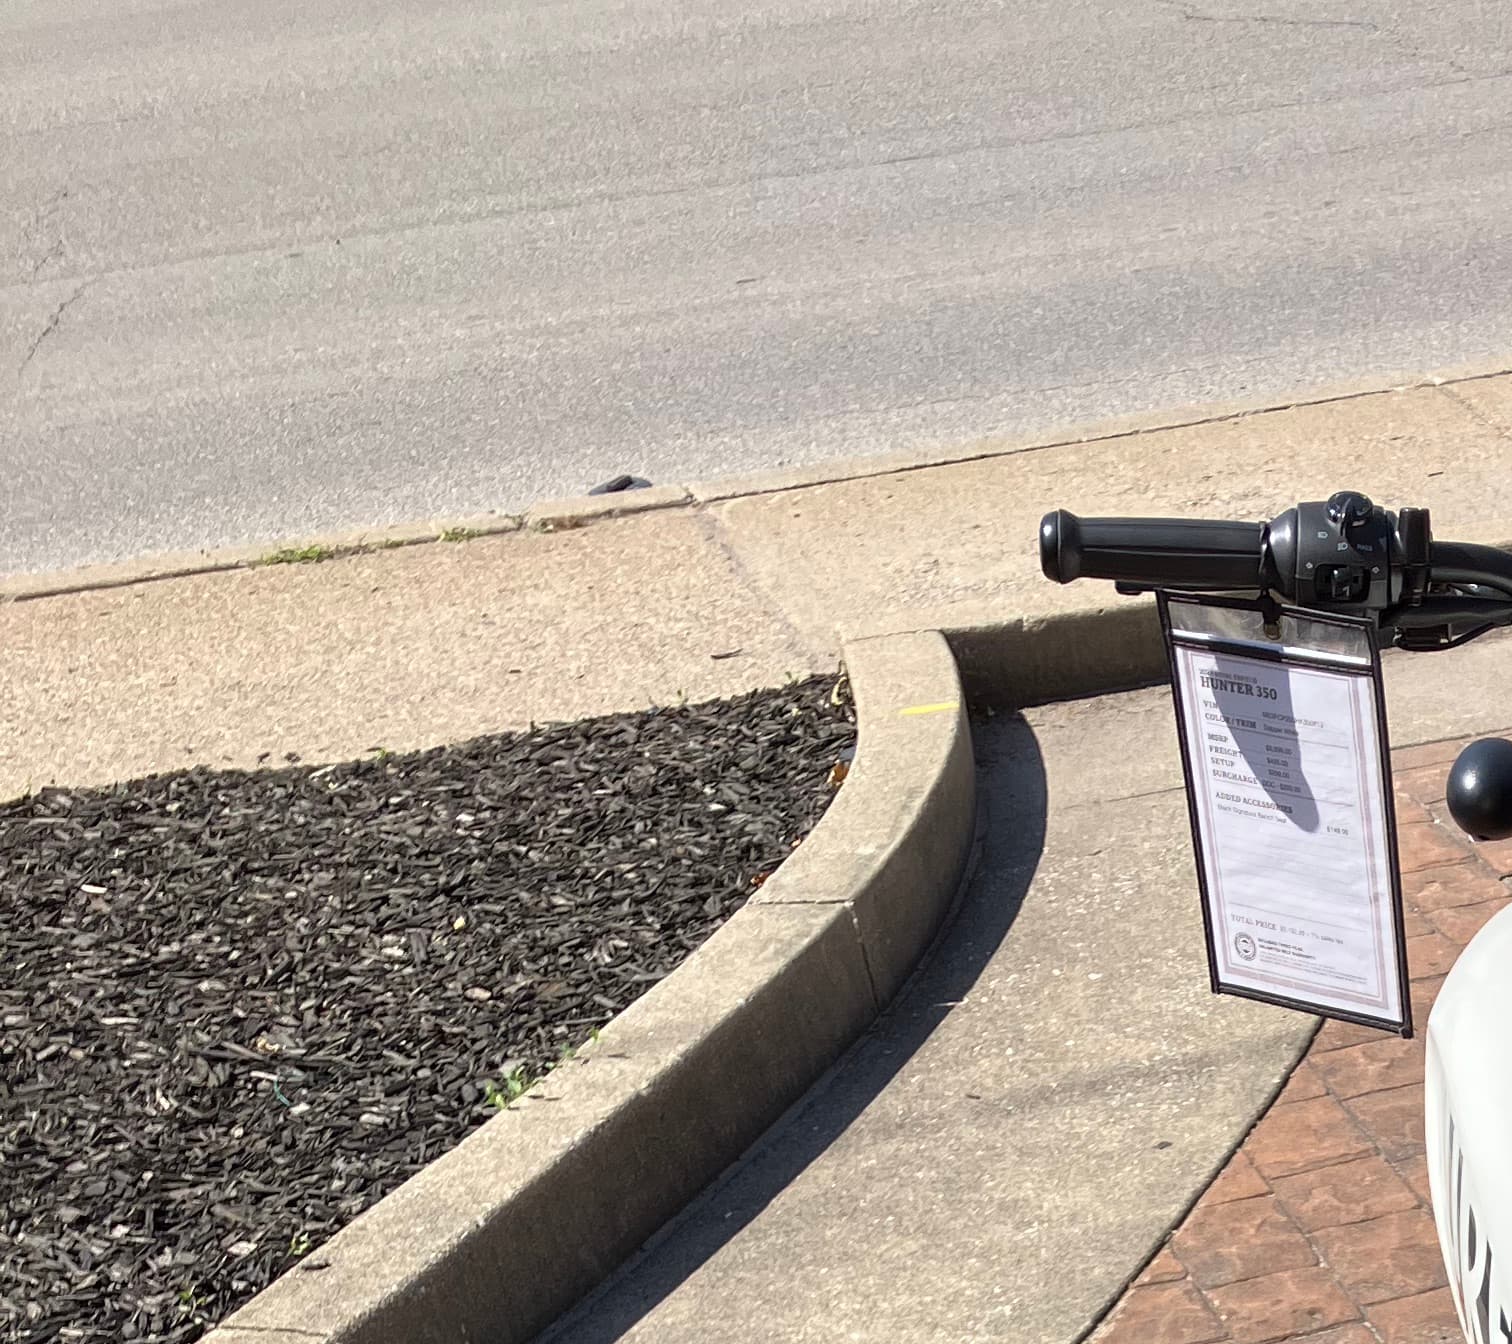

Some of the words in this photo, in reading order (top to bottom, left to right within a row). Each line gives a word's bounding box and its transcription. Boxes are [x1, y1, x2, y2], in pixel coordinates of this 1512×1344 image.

[1200, 676, 1254, 697] HUNTER
[1256, 685, 1278, 701] 350
[1211, 757, 1234, 767] SETUP
[1212, 768, 1258, 785] SURCHARGE
[1215, 792, 1242, 803] ADDED
[1242, 797, 1293, 814] ACCESSORIES
[1231, 913, 1254, 925] TOTAL
[1255, 919, 1277, 930] PRICE
